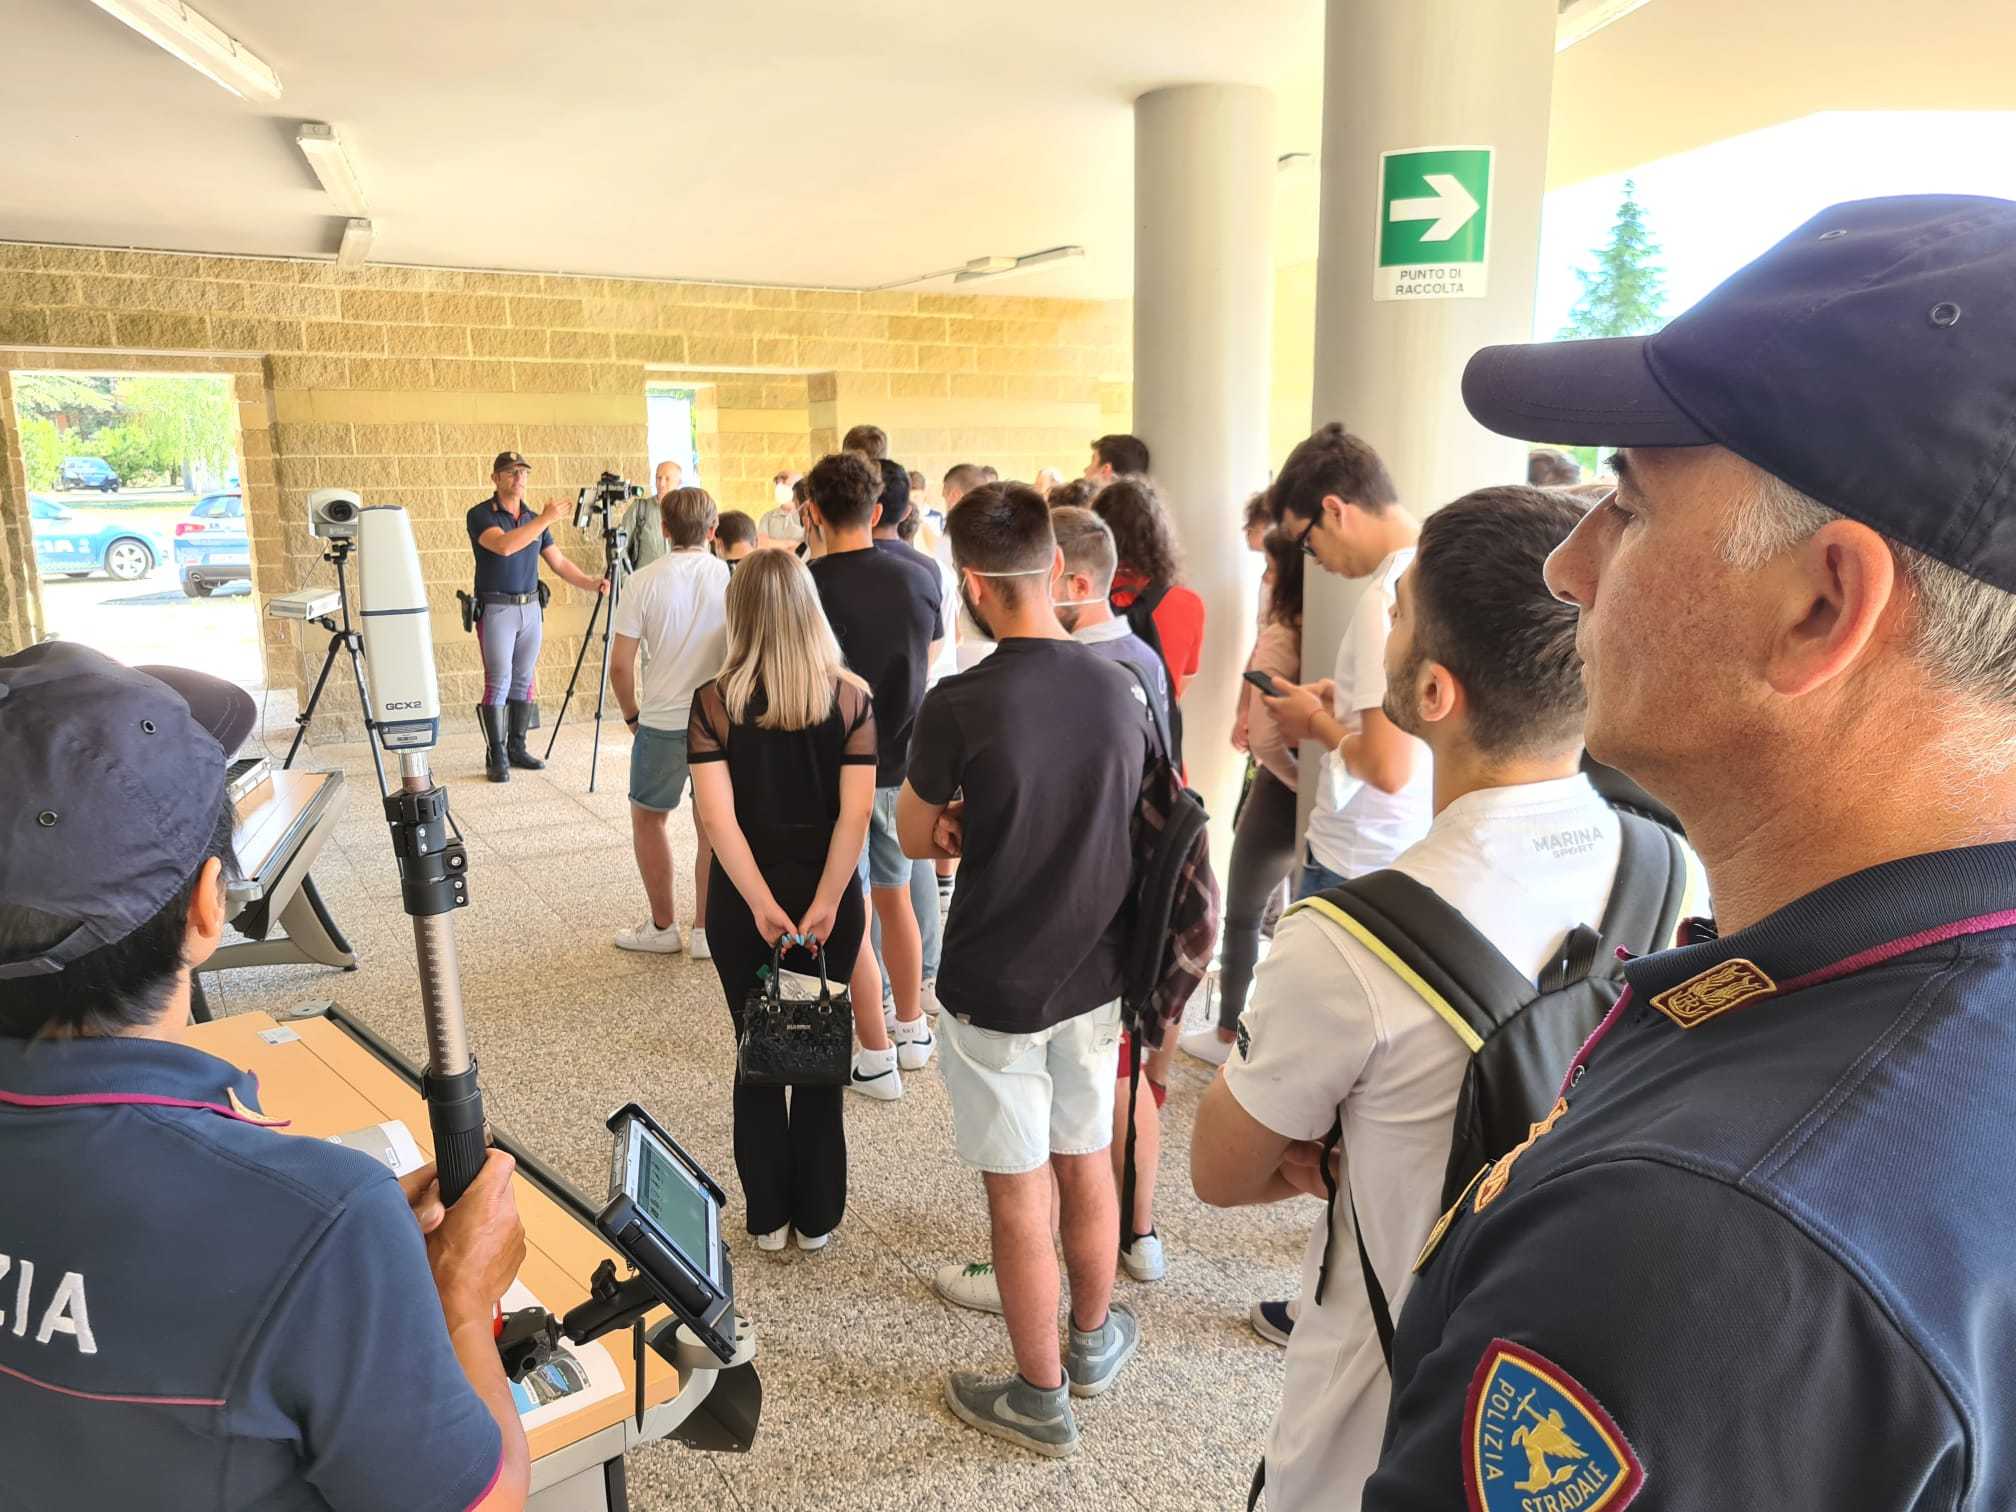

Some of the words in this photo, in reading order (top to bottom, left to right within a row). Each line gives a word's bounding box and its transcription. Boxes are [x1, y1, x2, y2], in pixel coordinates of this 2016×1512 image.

[1400, 268, 1445, 281] PUNTO
[1449, 267, 1462, 279] DI
[1395, 282, 1465, 295] RACCOLTA
[385, 701, 422, 711] GCX2
[1532, 826, 1604, 852] MARINA
[1552, 842, 1595, 859] SPORT
[1484, 1377, 1516, 1481] POLIZIA
[1521, 1460, 1609, 1512] STRADALE
